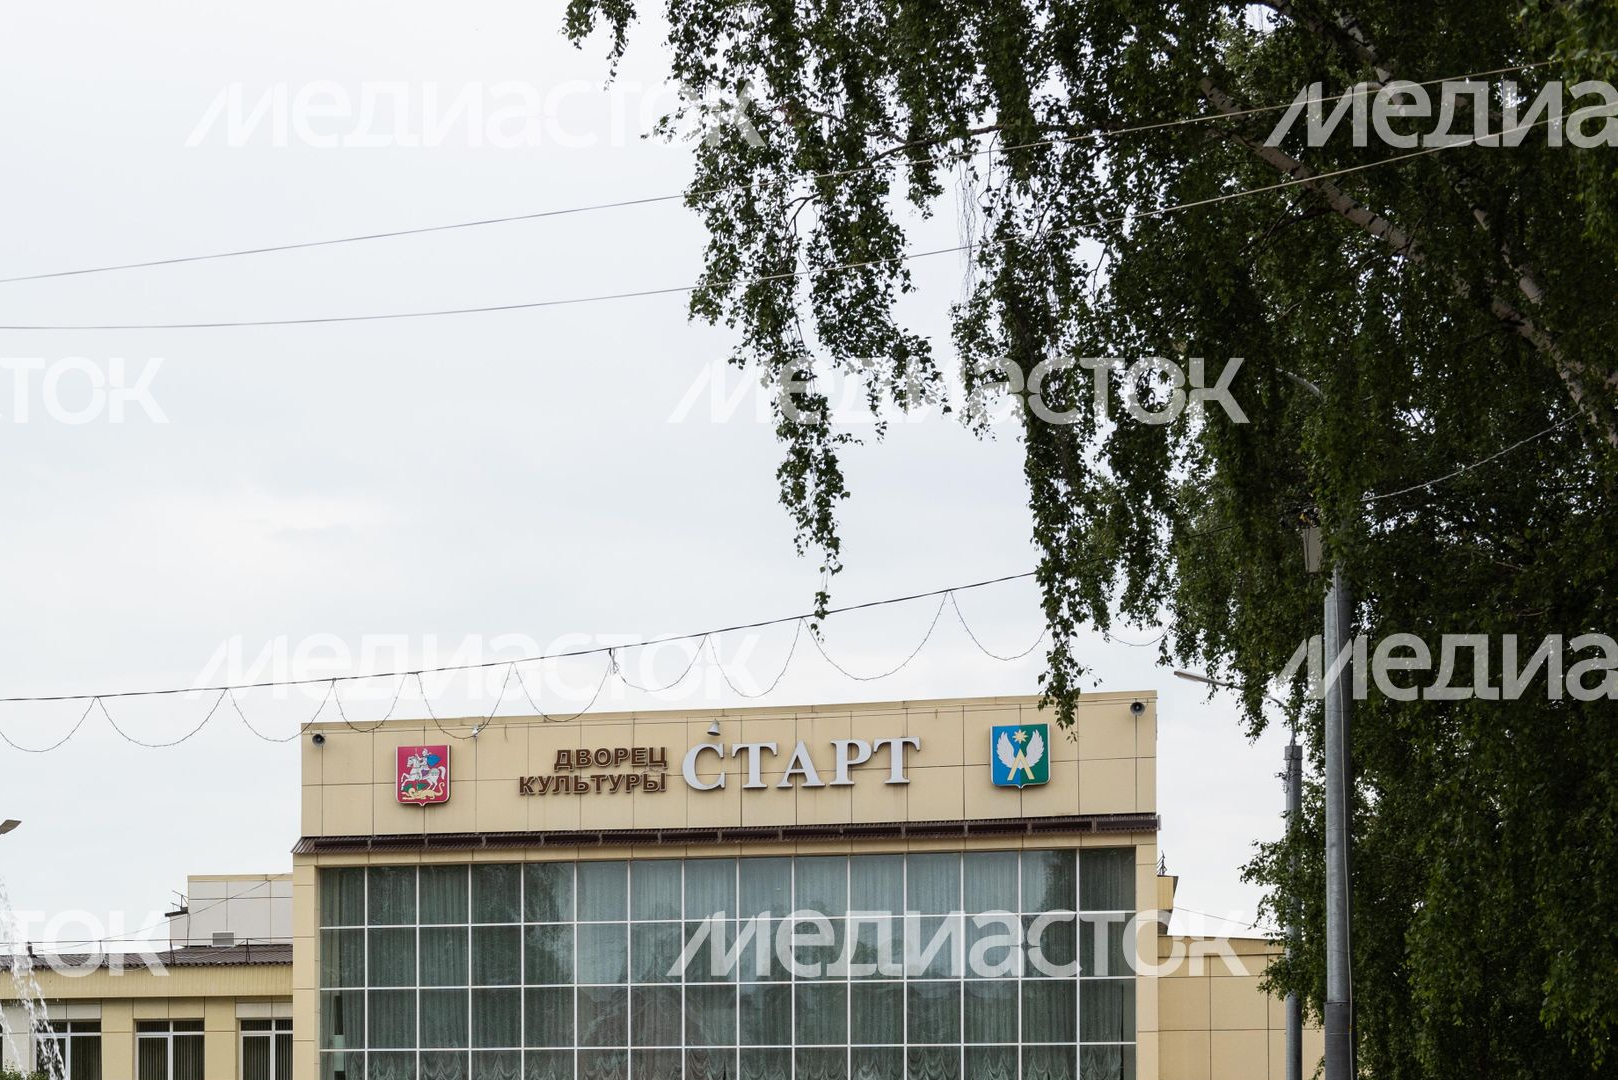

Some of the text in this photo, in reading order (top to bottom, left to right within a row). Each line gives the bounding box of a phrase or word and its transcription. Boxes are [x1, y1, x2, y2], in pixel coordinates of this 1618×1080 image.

[553, 746, 669, 772] ДВОРЕЦ
[682, 736, 921, 791] СТАРТ
[519, 772, 668, 796] КУЛЬТУРЫ
